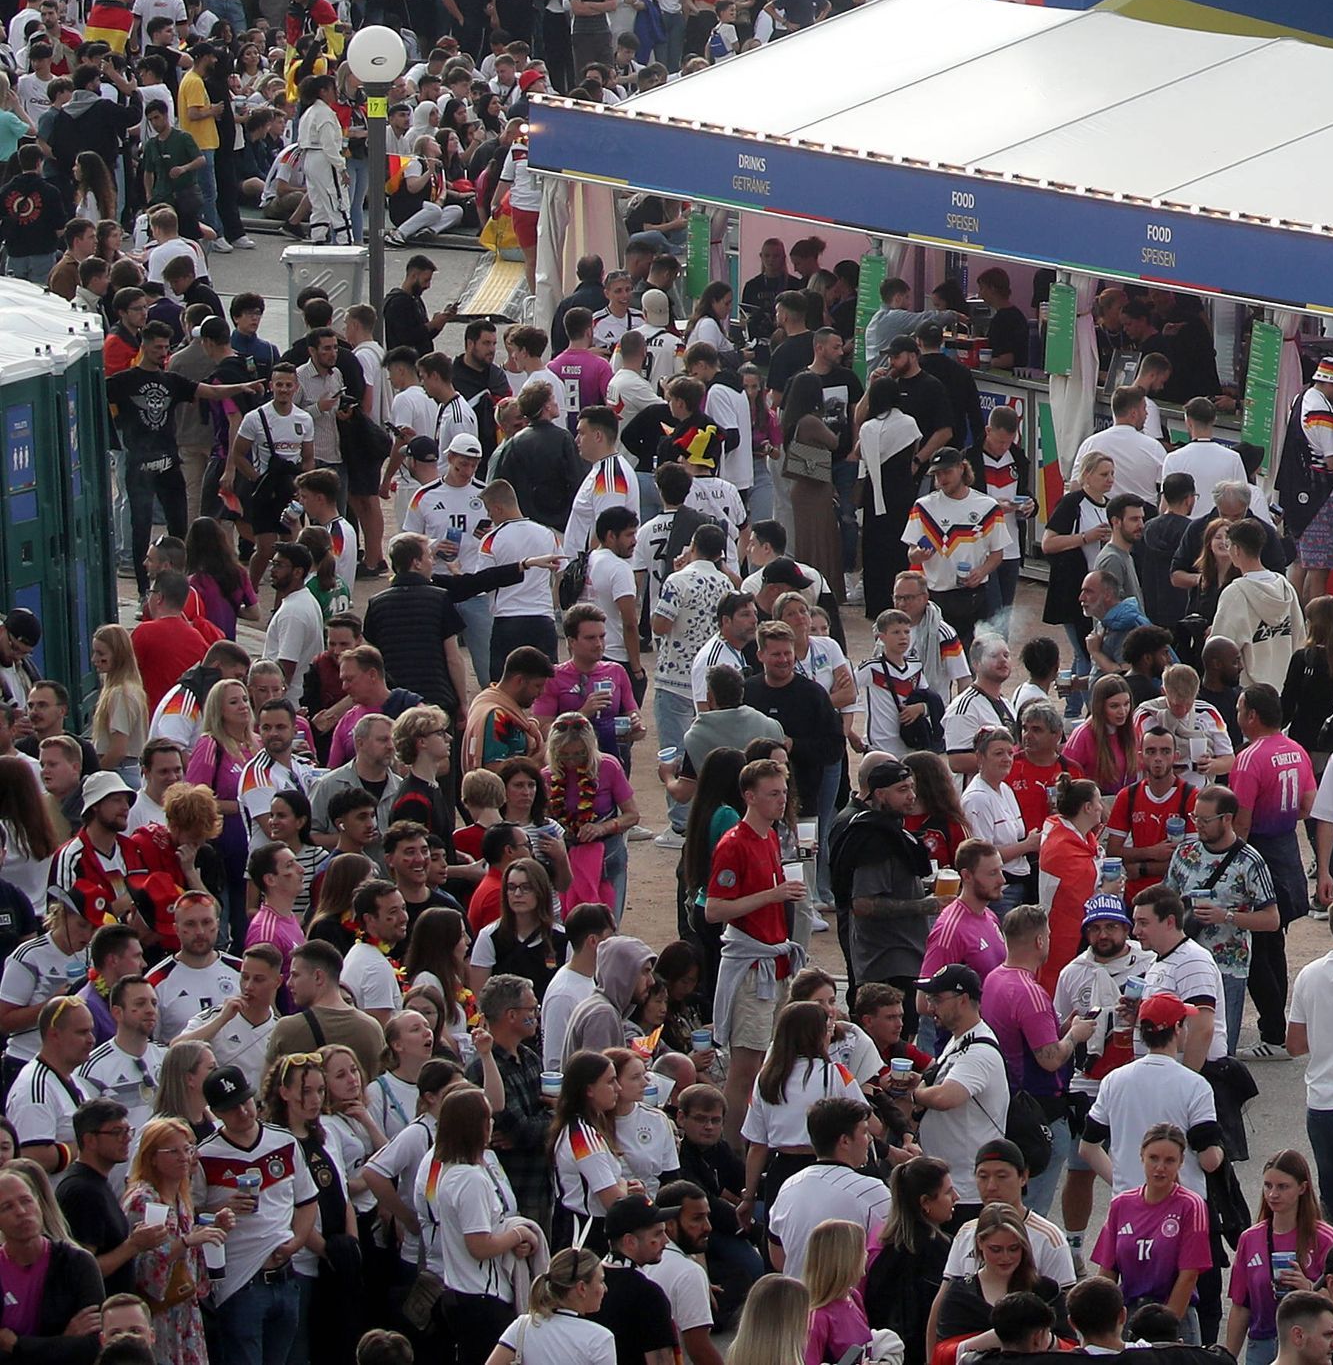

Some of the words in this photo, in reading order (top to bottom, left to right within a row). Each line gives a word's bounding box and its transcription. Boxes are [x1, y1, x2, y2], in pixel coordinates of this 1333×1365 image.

[738, 154, 766, 172] DRINKS
[732, 175, 771, 196] GETRÄNKE
[952, 191, 975, 209] FOOD
[946, 213, 979, 233] SPEISEN
[1147, 224, 1171, 243] FOOD
[1141, 247, 1176, 268] SPEISEN
[1271, 751, 1302, 767] FÜHRICH
[1278, 767, 1299, 812] 11
[1136, 1239, 1154, 1261] 17
